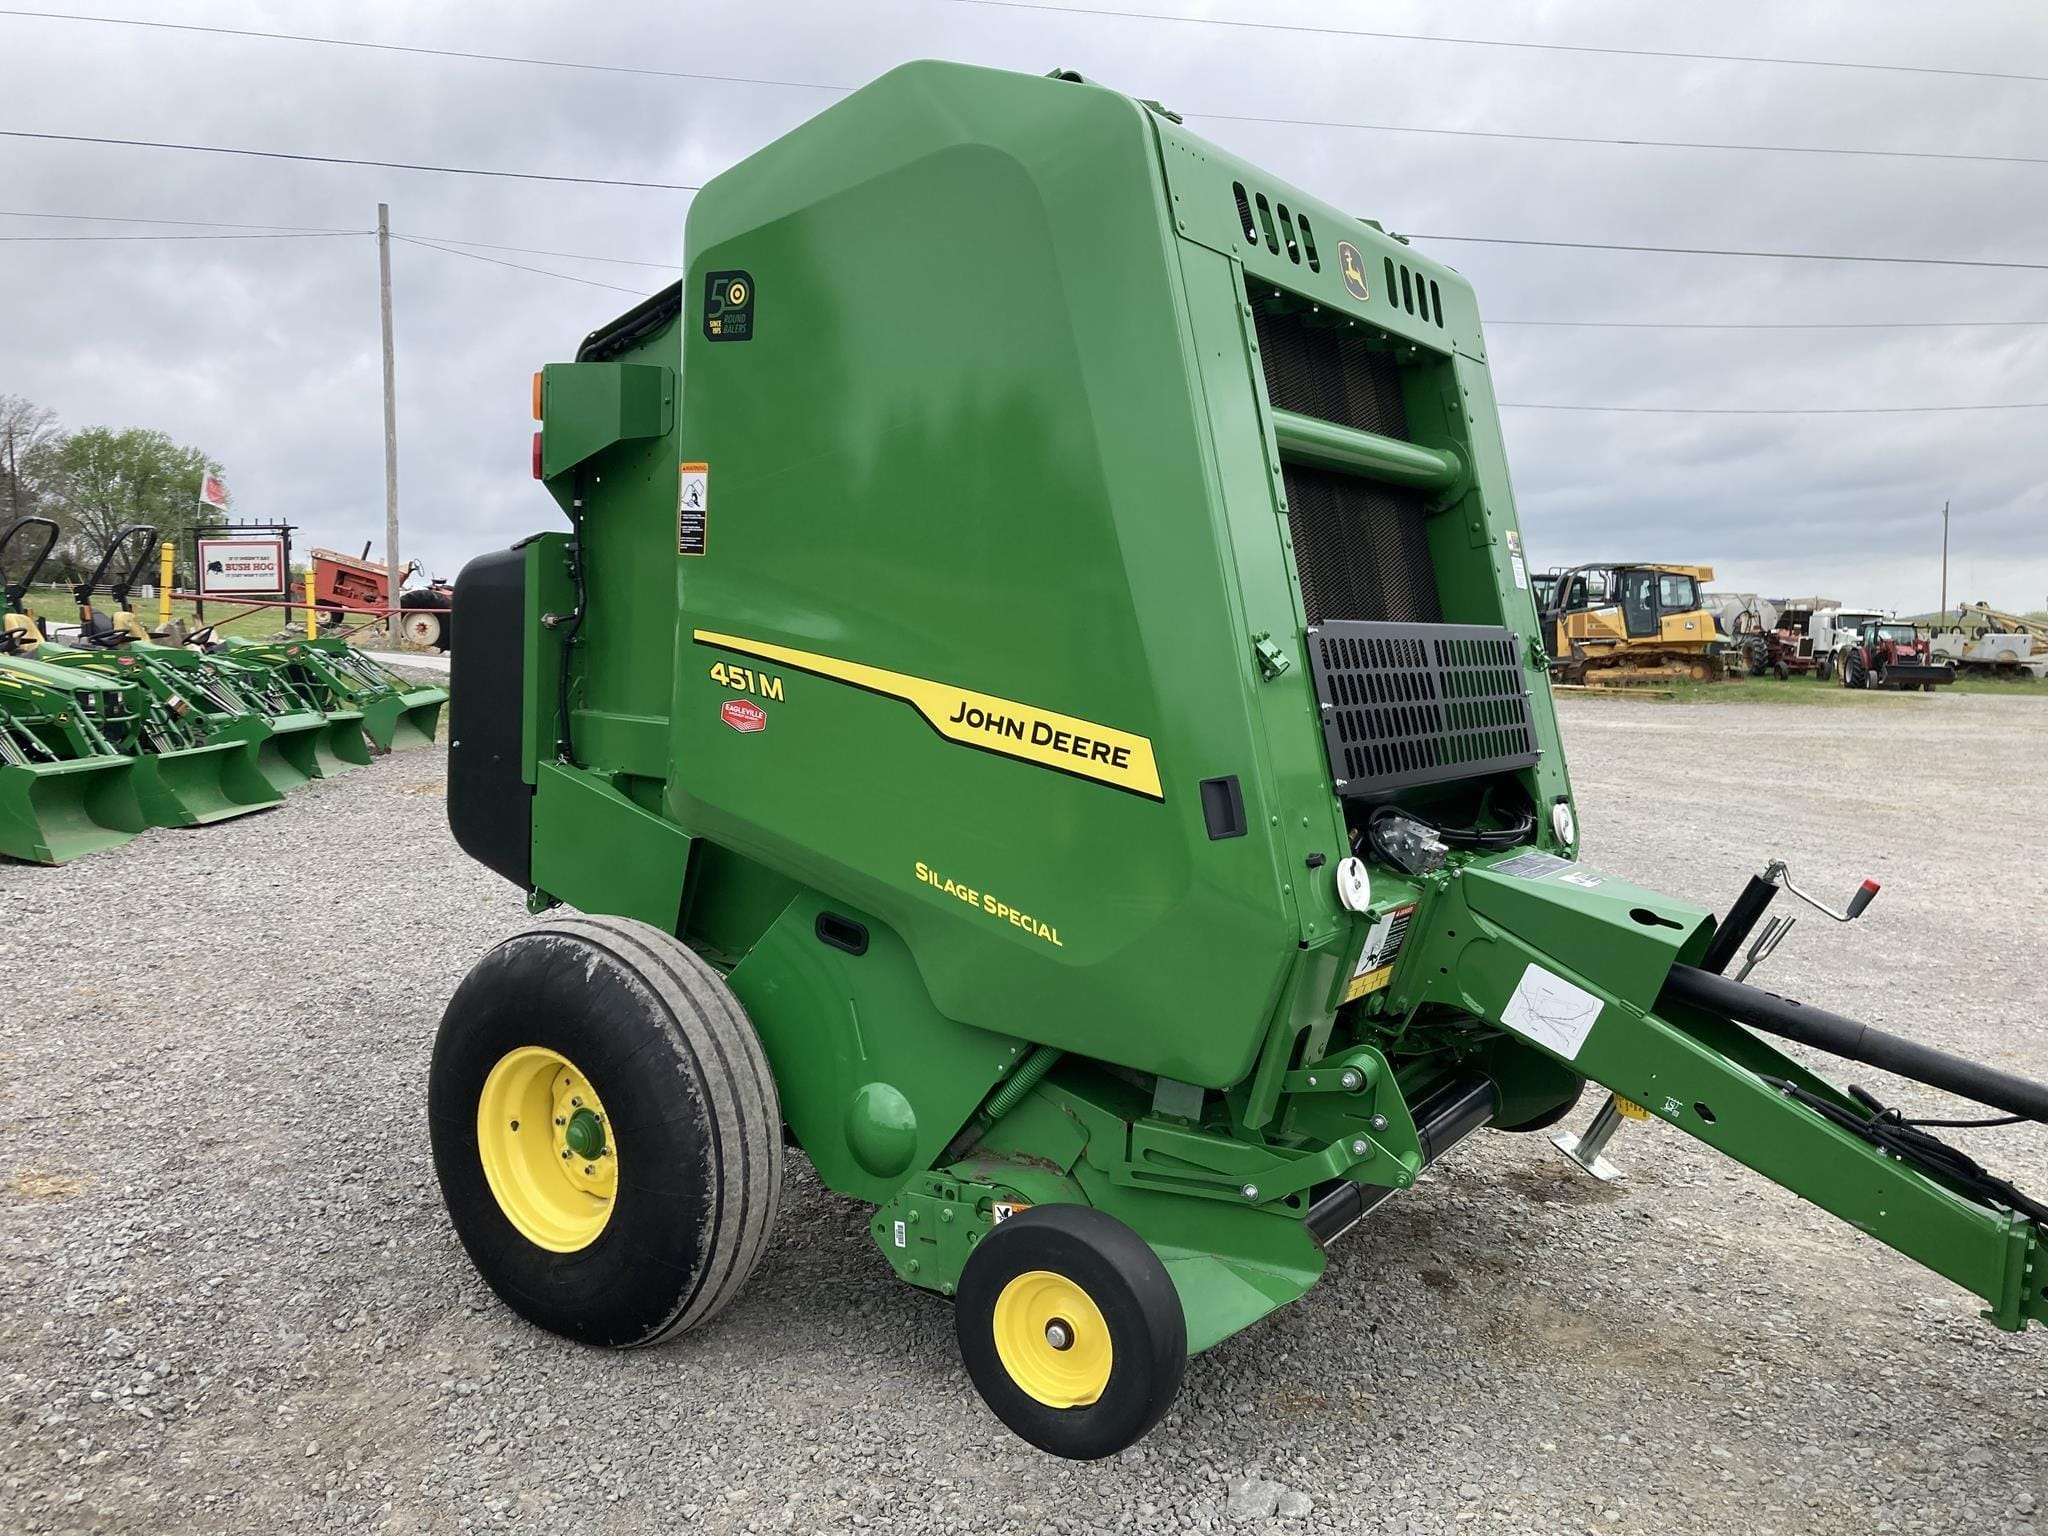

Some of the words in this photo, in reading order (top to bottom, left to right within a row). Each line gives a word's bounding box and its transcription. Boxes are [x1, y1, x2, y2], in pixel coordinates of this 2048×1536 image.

[225, 563, 250, 571] BUSH
[253, 563, 274, 571] HOG
[709, 661, 756, 695] 451
[758, 672, 785, 702] M
[725, 703, 764, 719] EAGLEVILLE
[949, 701, 1025, 741] JOHN
[1030, 720, 1131, 769] DEERE
[915, 861, 980, 907] SILAGE
[983, 894, 1063, 947] SPECIAL
